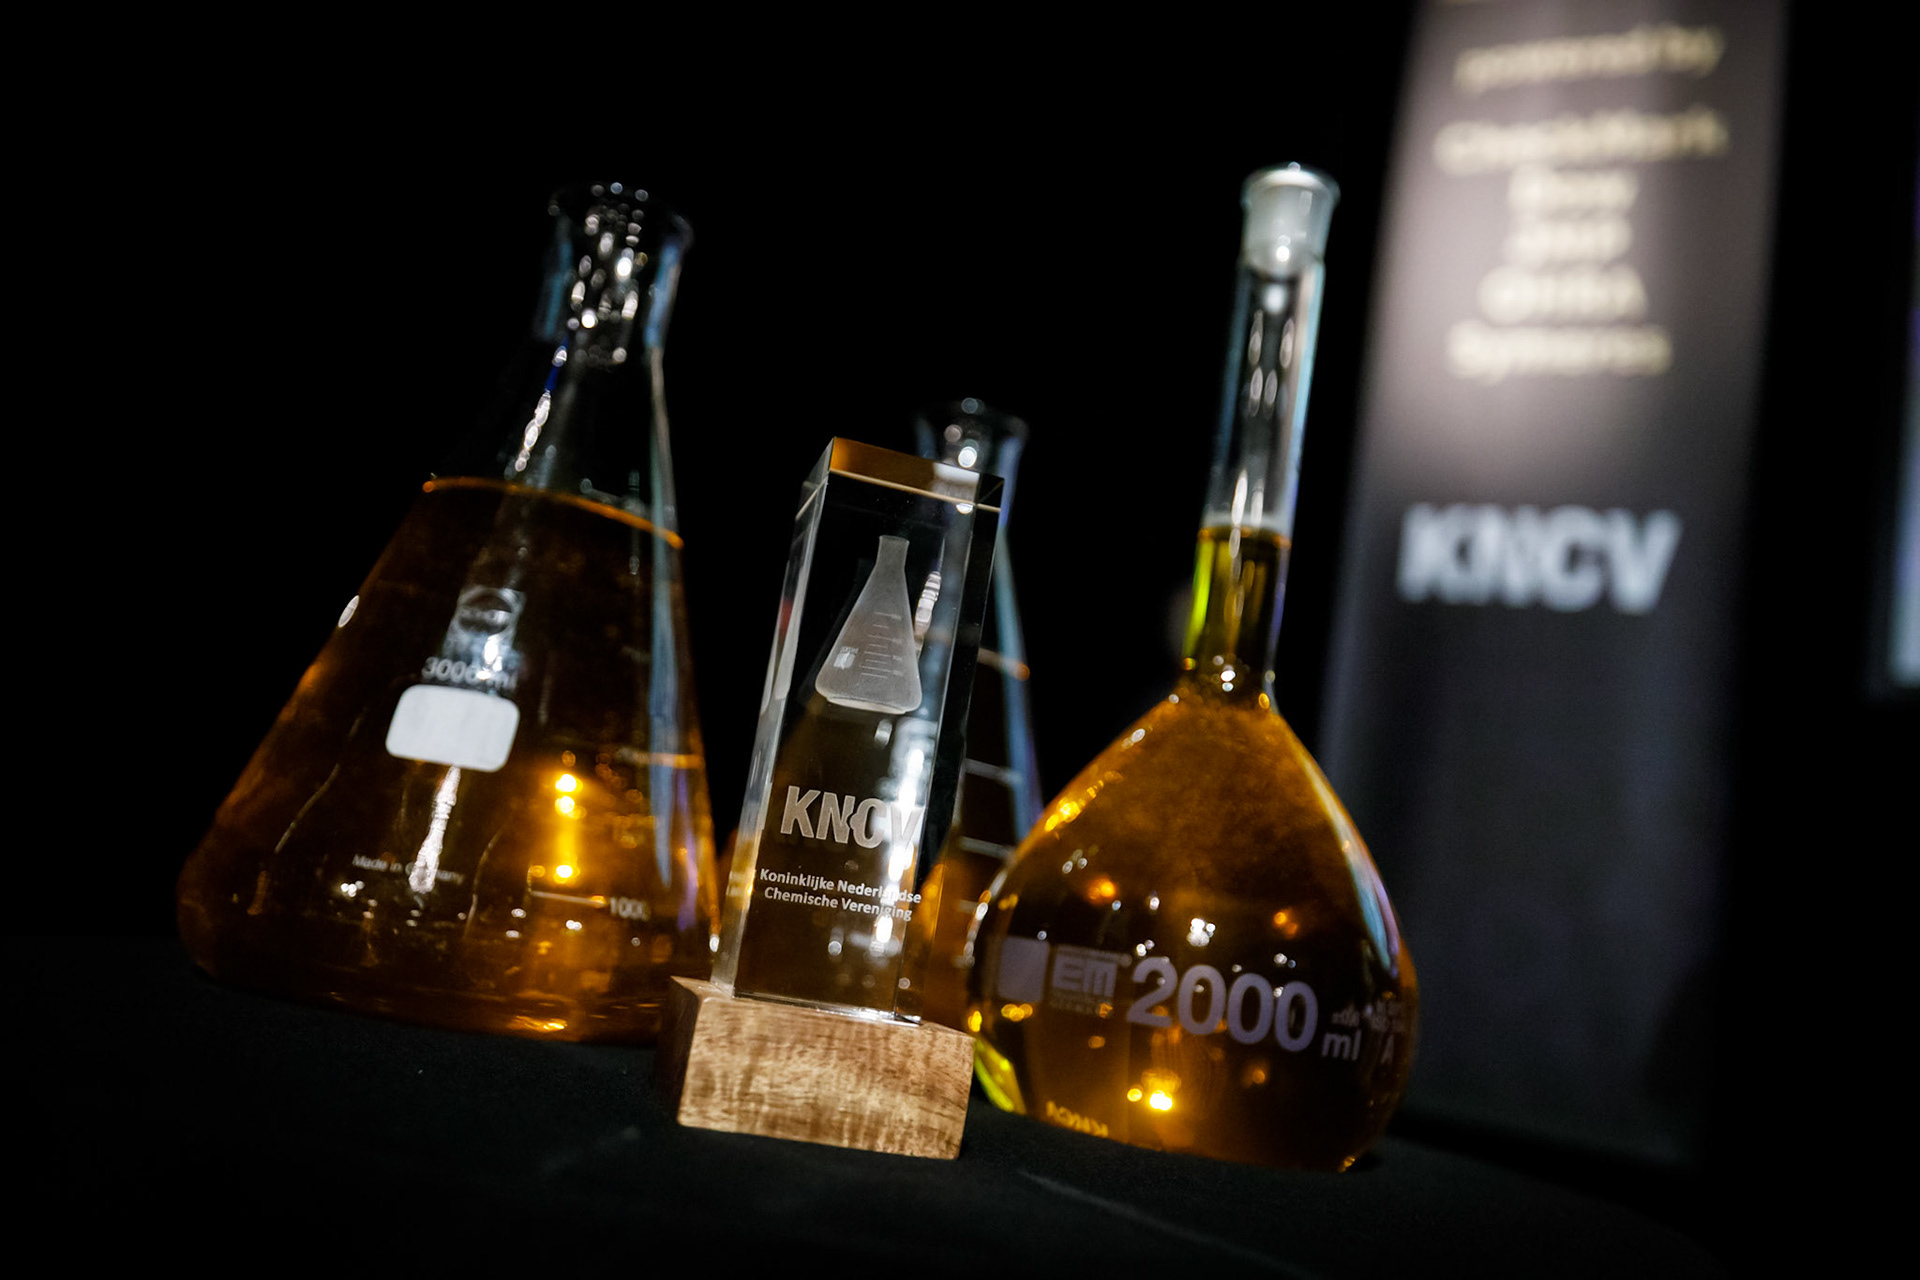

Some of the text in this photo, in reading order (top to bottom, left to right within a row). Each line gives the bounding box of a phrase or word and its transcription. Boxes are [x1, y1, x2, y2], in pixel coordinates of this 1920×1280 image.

[1401, 504, 1682, 614] KNCV
[780, 785, 926, 849] KNCV
[352, 854, 388, 873] Made
[389, 860, 404, 873] in
[760, 868, 835, 891] Koninklijke
[764, 886, 913, 922] Chemische Vereniging
[1126, 956, 1319, 1053] 2000
[1321, 1028, 1362, 1062] ml
